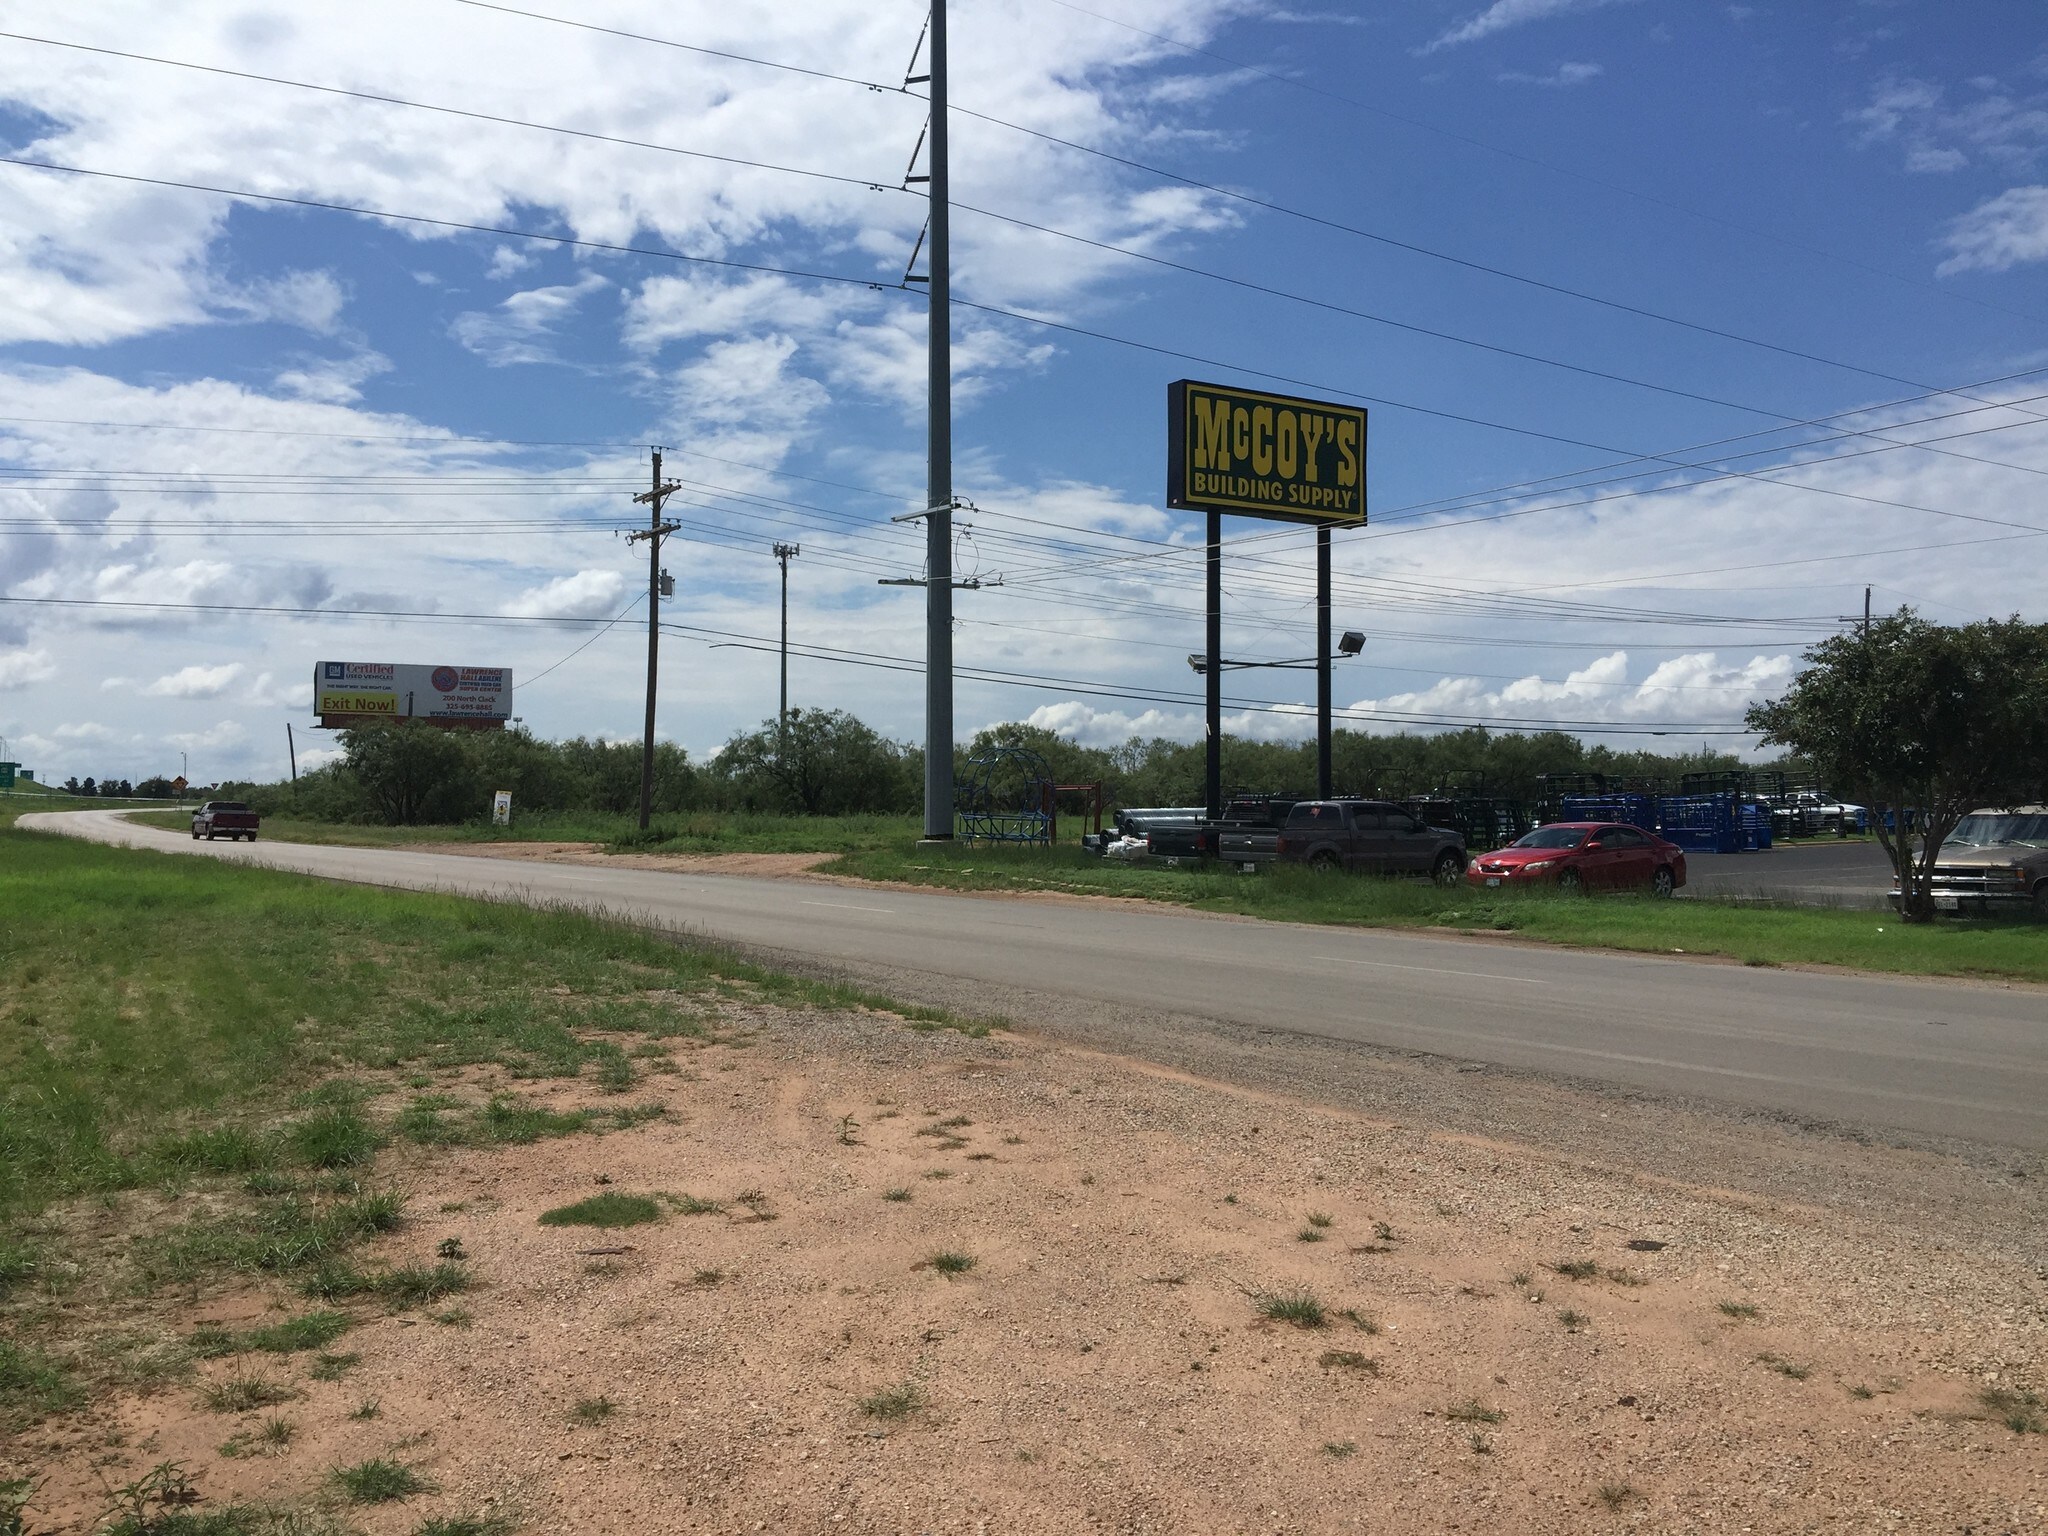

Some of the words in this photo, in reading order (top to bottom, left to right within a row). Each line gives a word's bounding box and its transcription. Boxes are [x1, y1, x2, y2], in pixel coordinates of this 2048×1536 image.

[1194, 472, 1283, 501] BUILDING
[1288, 483, 1353, 509] SUPPLY
[329, 665, 341, 675] GM
[346, 663, 394, 674] Certified
[461, 668, 503, 676] LAWRENCE
[323, 697, 351, 710] Exit
[355, 698, 395, 711] Now!
[429, 709, 508, 718] www.lawrencehall.com
